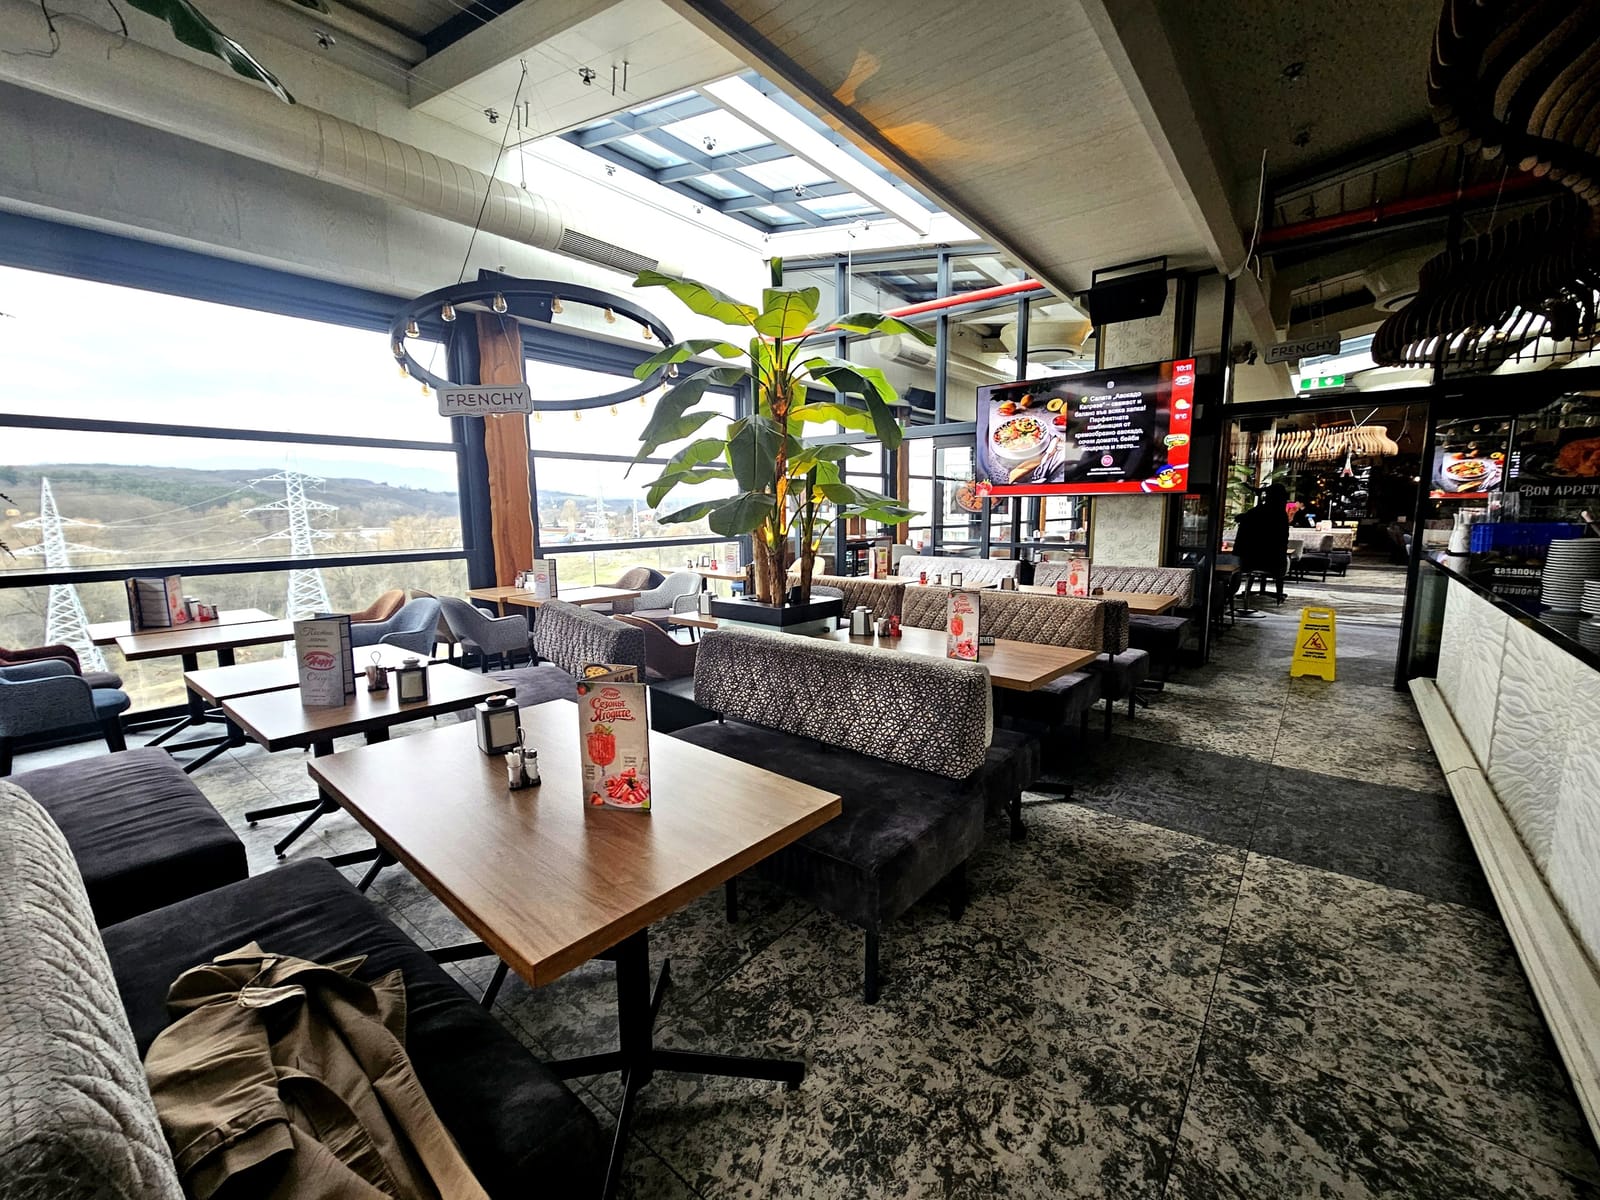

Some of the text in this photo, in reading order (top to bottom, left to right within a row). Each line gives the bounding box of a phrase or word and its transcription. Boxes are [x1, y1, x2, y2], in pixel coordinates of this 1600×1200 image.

[1271, 341, 1334, 357] FRENCHY
[446, 392, 523, 406] FRENCHY
[1519, 484, 1550, 496] BON
[590, 708, 635, 723] Ягодите
